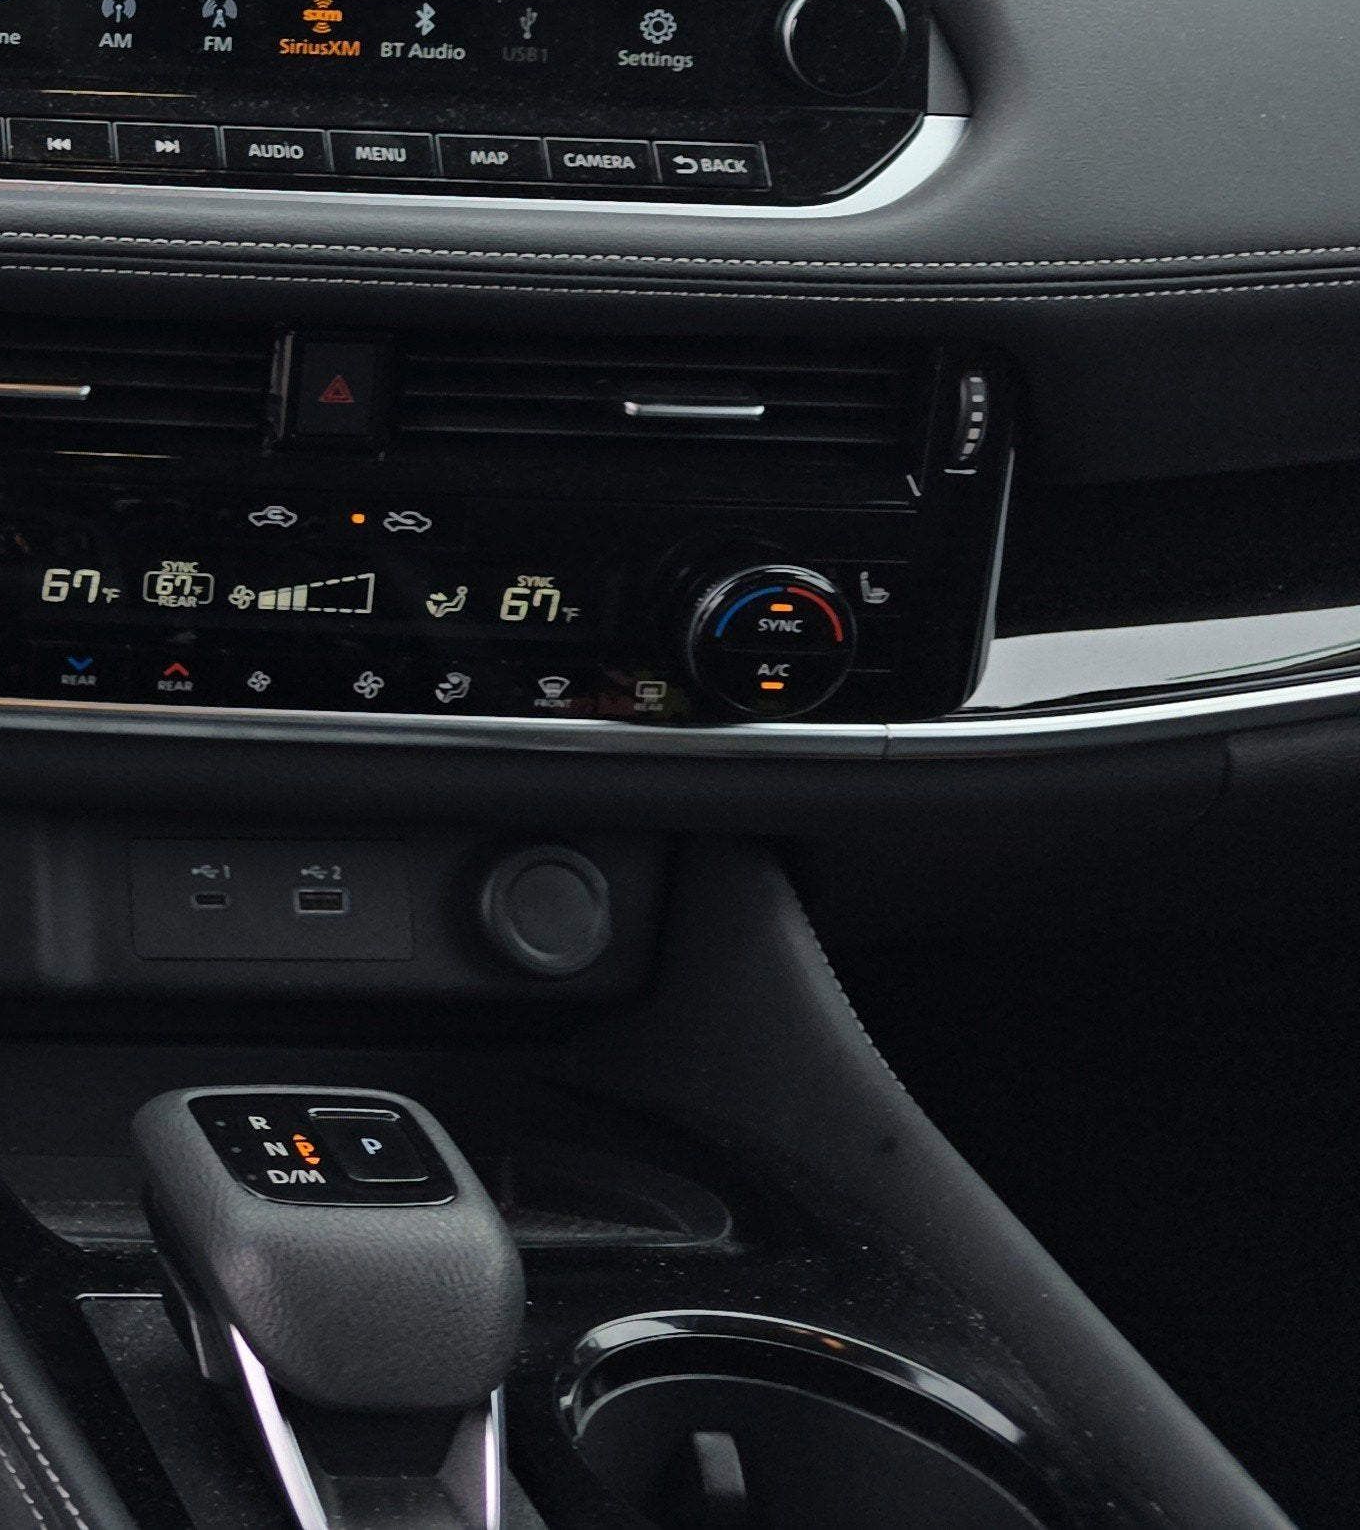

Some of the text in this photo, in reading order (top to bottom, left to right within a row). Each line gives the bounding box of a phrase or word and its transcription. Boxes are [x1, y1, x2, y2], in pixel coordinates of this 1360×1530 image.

[98, 33, 133, 49] AM
[204, 37, 233, 52] FM
[279, 38, 361, 57] SiriusXM
[380, 42, 467, 60] BT Audio
[617, 49, 694, 72] Settings
[249, 143, 304, 160] AUDIO
[355, 145, 407, 163] MENU
[470, 148, 510, 166] MAP
[563, 152, 636, 170] CAMERA
[700, 157, 748, 175] BACK
[158, 595, 198, 608] REAR
[758, 618, 804, 633] SYNC
[757, 663, 791, 677] A/C
[60, 674, 97, 686] REAR
[157, 680, 193, 692] REAR
[247, 1115, 271, 1130] R
[263, 1141, 315, 1157] N P
[360, 1137, 383, 1155] P
[266, 1169, 327, 1184] D/M
